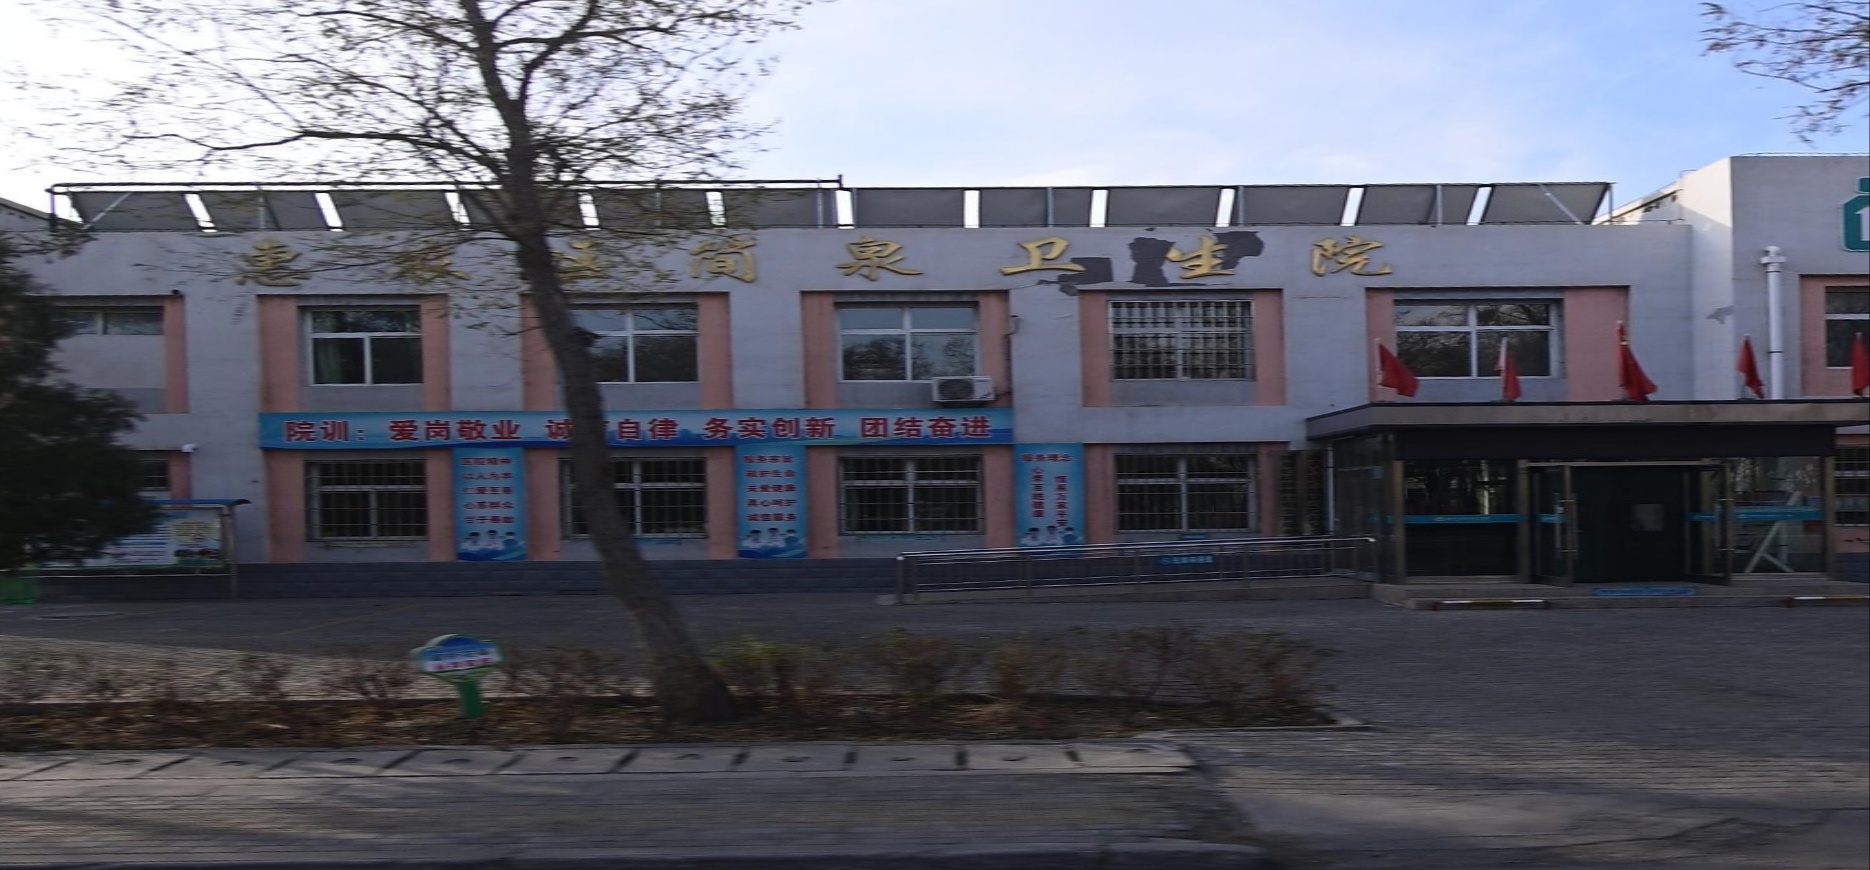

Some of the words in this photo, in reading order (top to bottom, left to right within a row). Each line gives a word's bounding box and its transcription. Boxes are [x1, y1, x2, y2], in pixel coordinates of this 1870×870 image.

[389, 419, 521, 442] 爱岗敬业
[545, 417, 679, 441] 诚自律
[704, 417, 835, 441] 务实创新
[860, 416, 993, 440] 团结奋进
